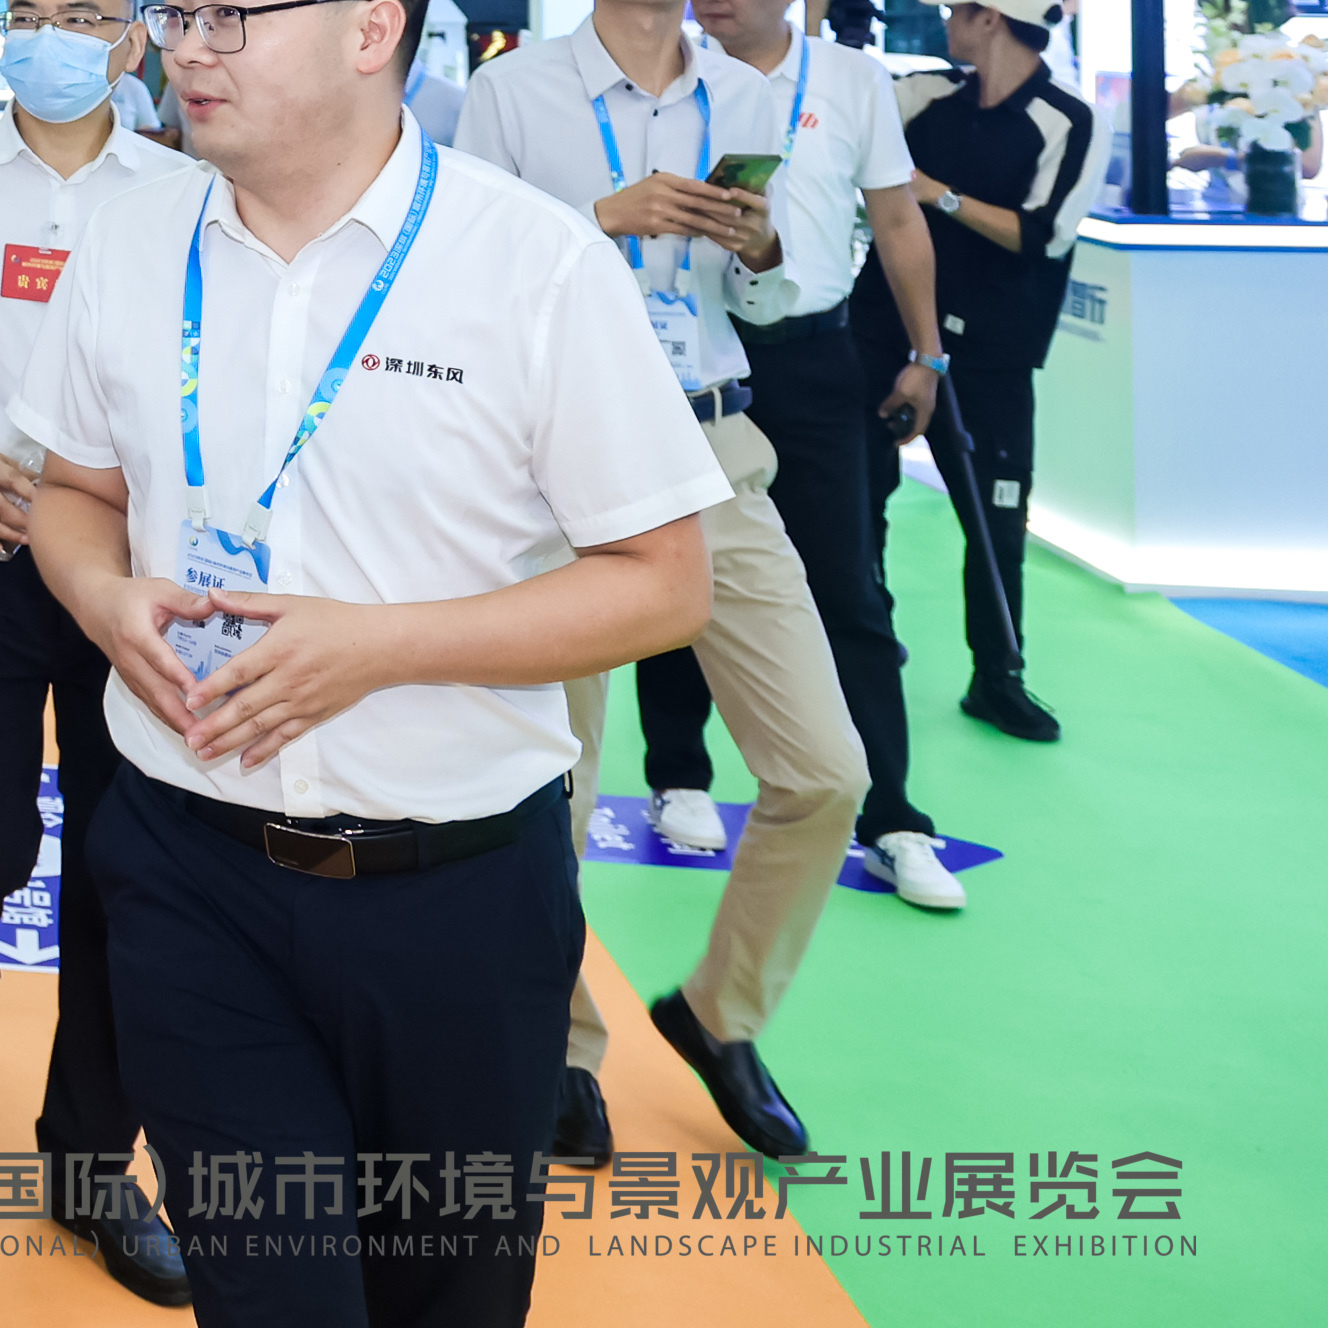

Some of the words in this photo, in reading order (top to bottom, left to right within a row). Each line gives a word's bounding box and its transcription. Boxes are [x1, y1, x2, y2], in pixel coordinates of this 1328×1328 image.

[384, 355, 465, 386] 深圳东风
[186, 567, 226, 589] 参展证
